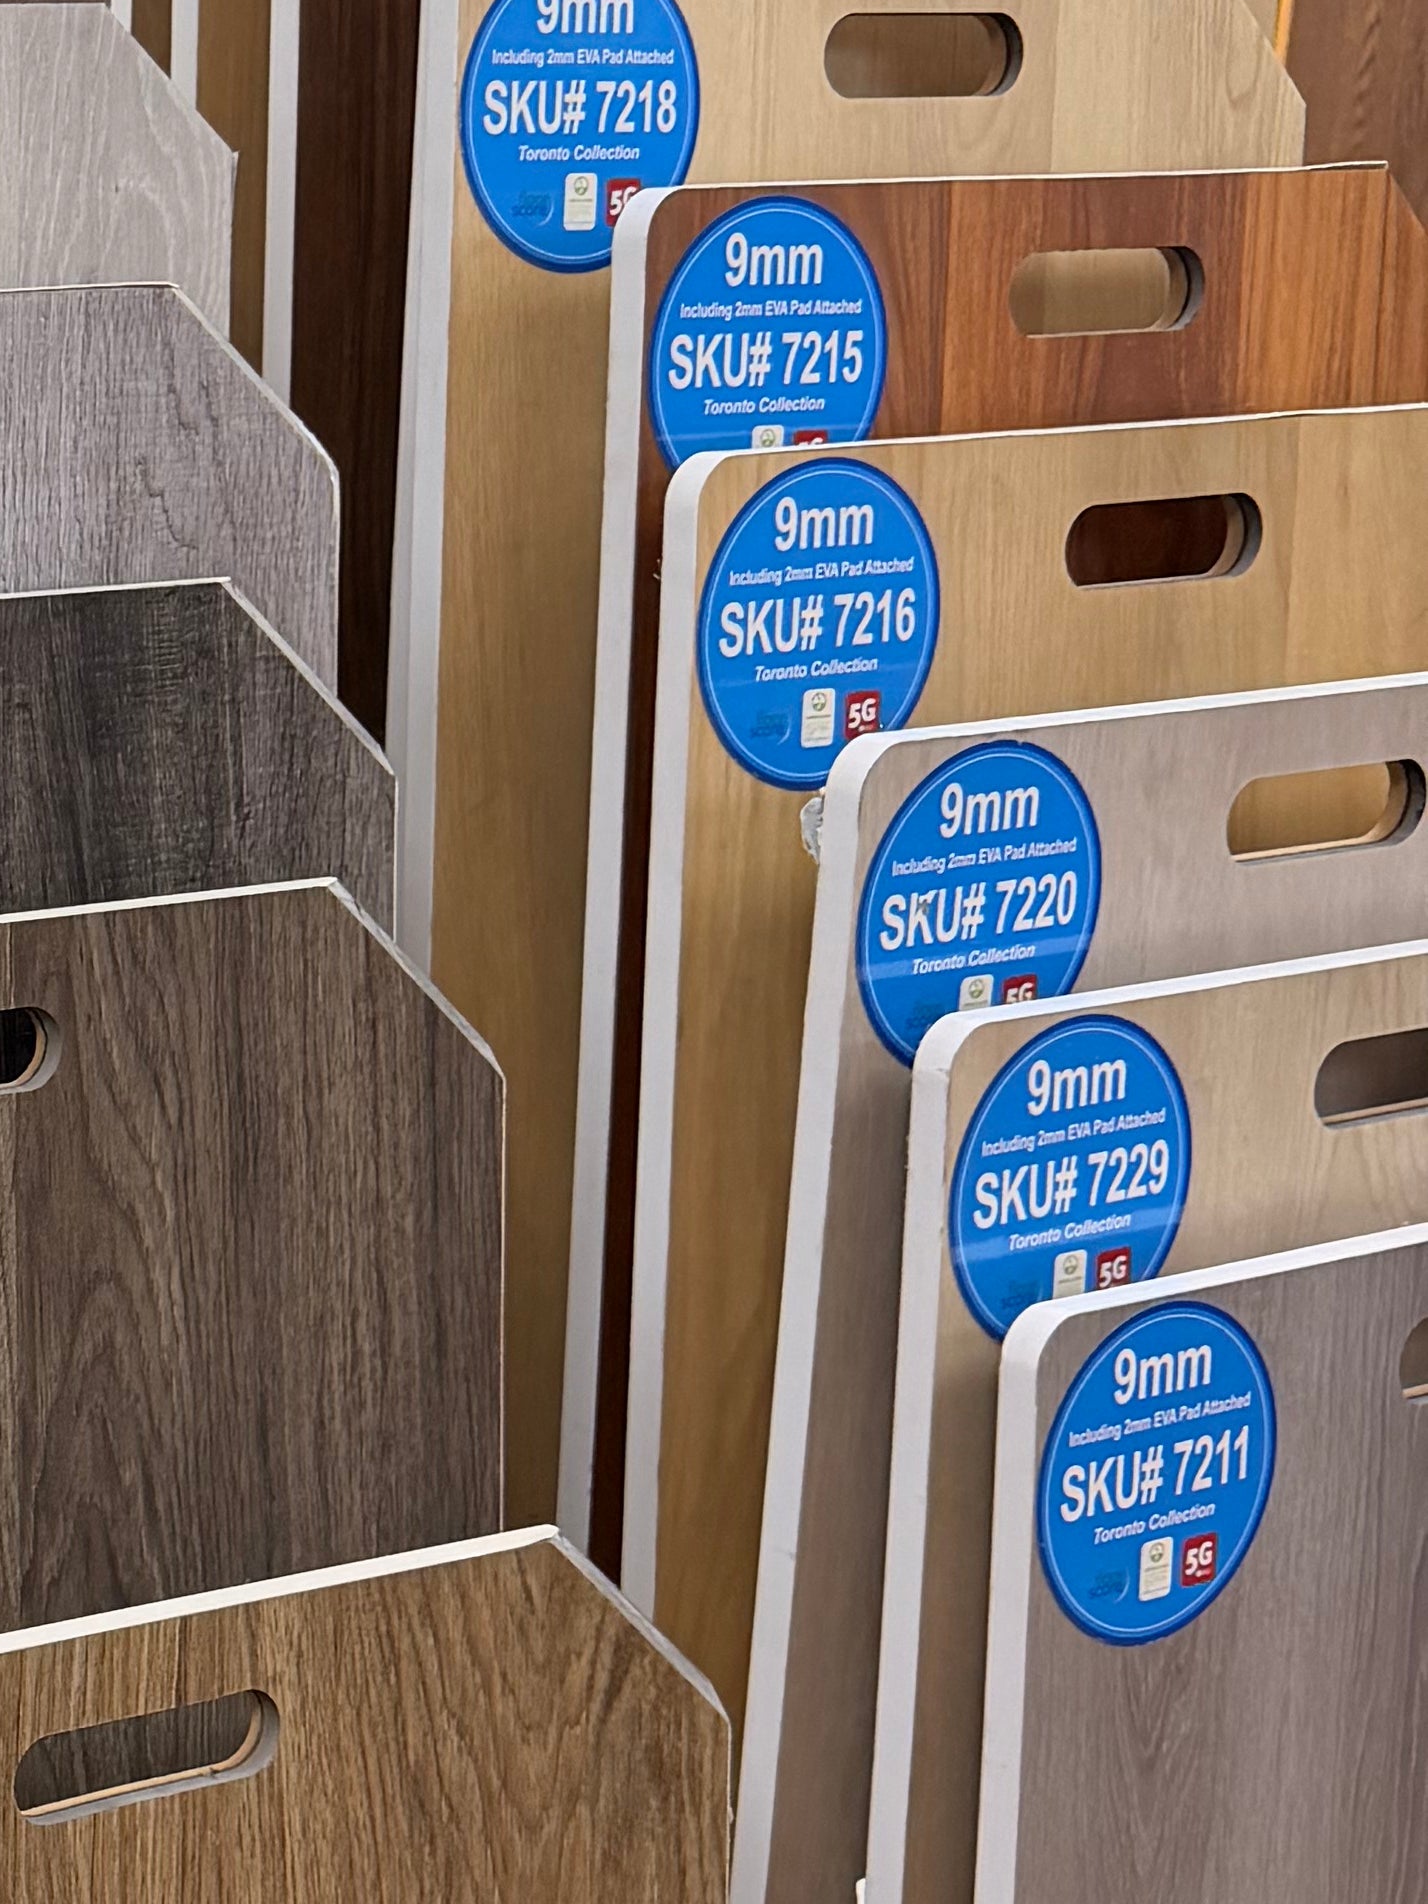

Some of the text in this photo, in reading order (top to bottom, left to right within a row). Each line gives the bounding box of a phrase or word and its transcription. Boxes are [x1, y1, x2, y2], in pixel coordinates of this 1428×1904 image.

[483, 79, 677, 135] SKU# 7218
[725, 232, 823, 287] 9mm
[680, 299, 862, 321] Including 2mm EVA Pad Attached
[668, 329, 864, 390] SKU# 7215
[704, 396, 825, 415] Toronto Collection
[774, 496, 874, 552] 9mm
[718, 587, 916, 658] SKU# 7216
[847, 698, 878, 730] 5G
[939, 782, 1040, 839] 9mm
[879, 870, 1077, 951] SKU# 7220
[1027, 1059, 1127, 1116] 9mm
[973, 1139, 1169, 1230] SKU# 7229
[1114, 1344, 1212, 1405] 9mm
[1060, 1425, 1249, 1523] SKU# 7211
[1184, 1539, 1214, 1574] 5G
